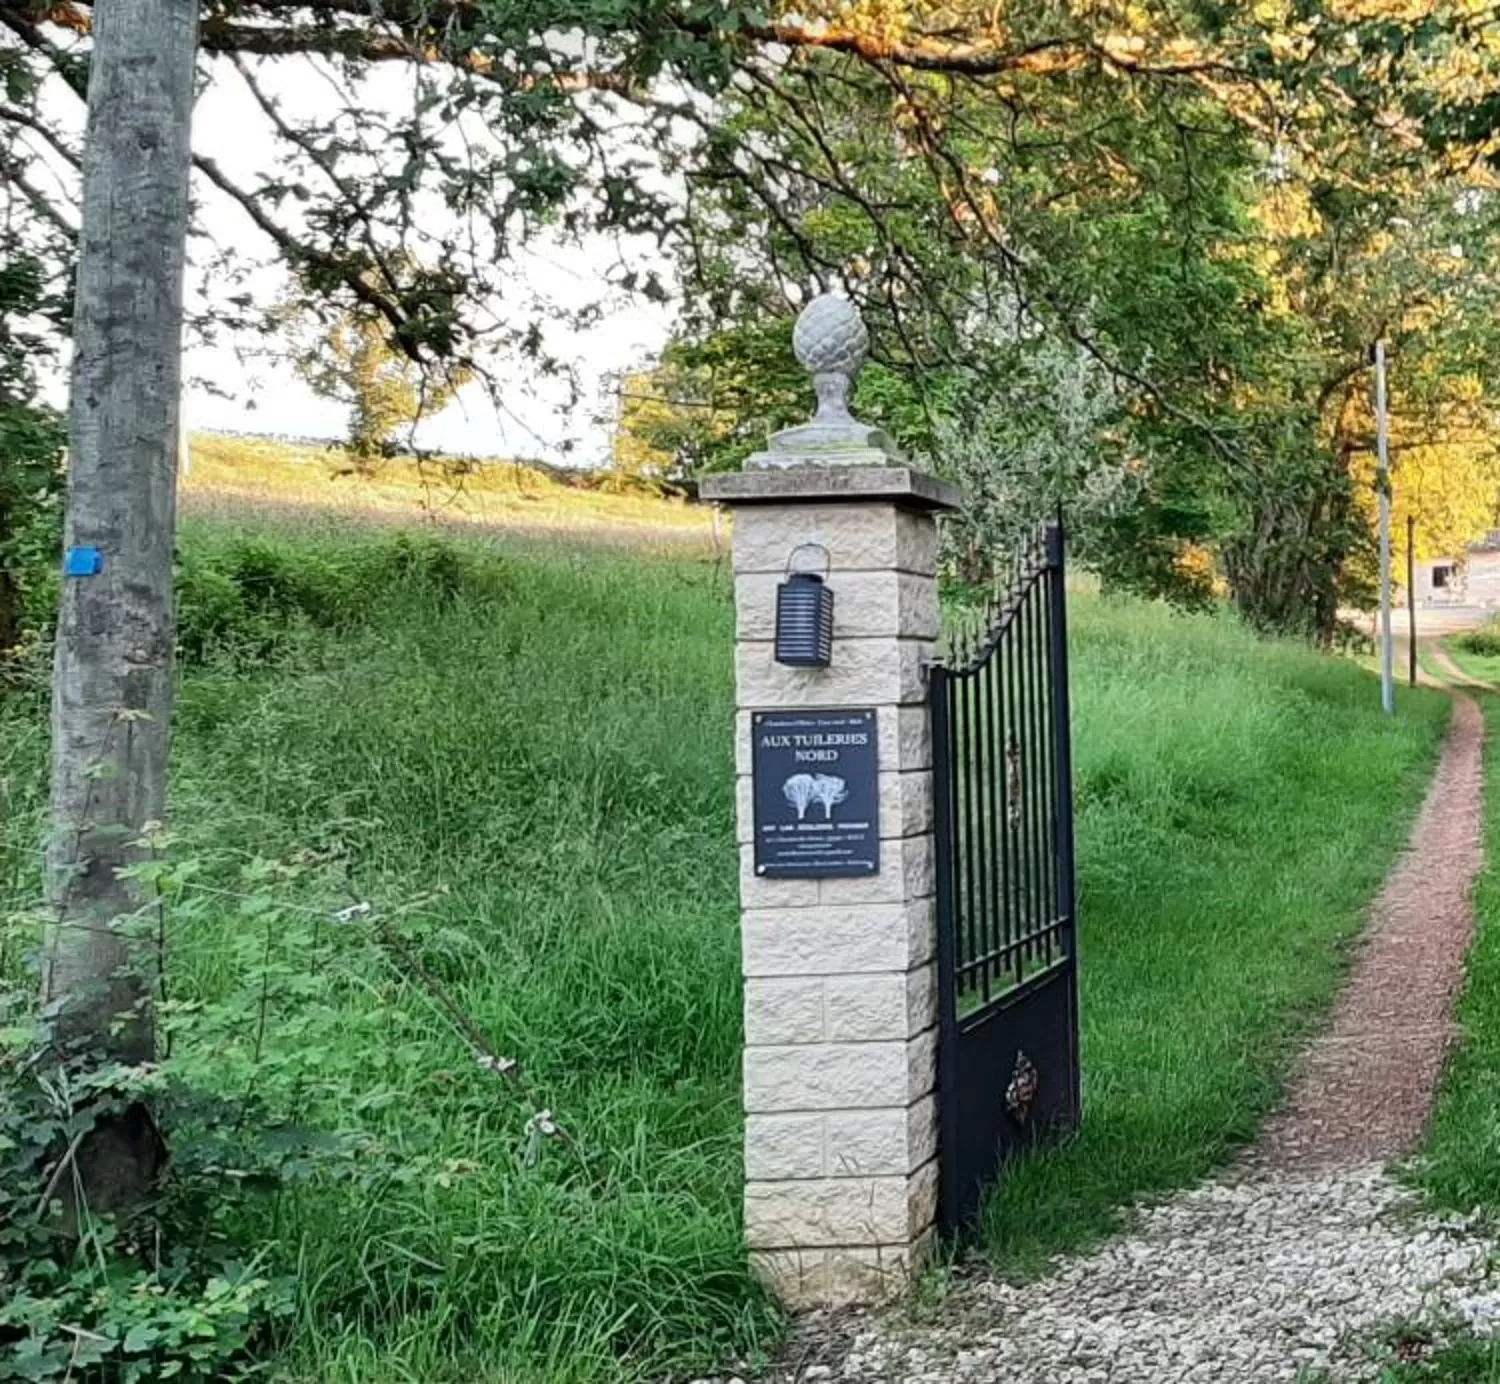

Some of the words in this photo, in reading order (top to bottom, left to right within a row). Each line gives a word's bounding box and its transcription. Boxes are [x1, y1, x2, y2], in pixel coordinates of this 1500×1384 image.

[761, 735, 791, 747] AUX
[792, 733, 868, 746] TUILERIES
[795, 749, 839, 761] NORD
